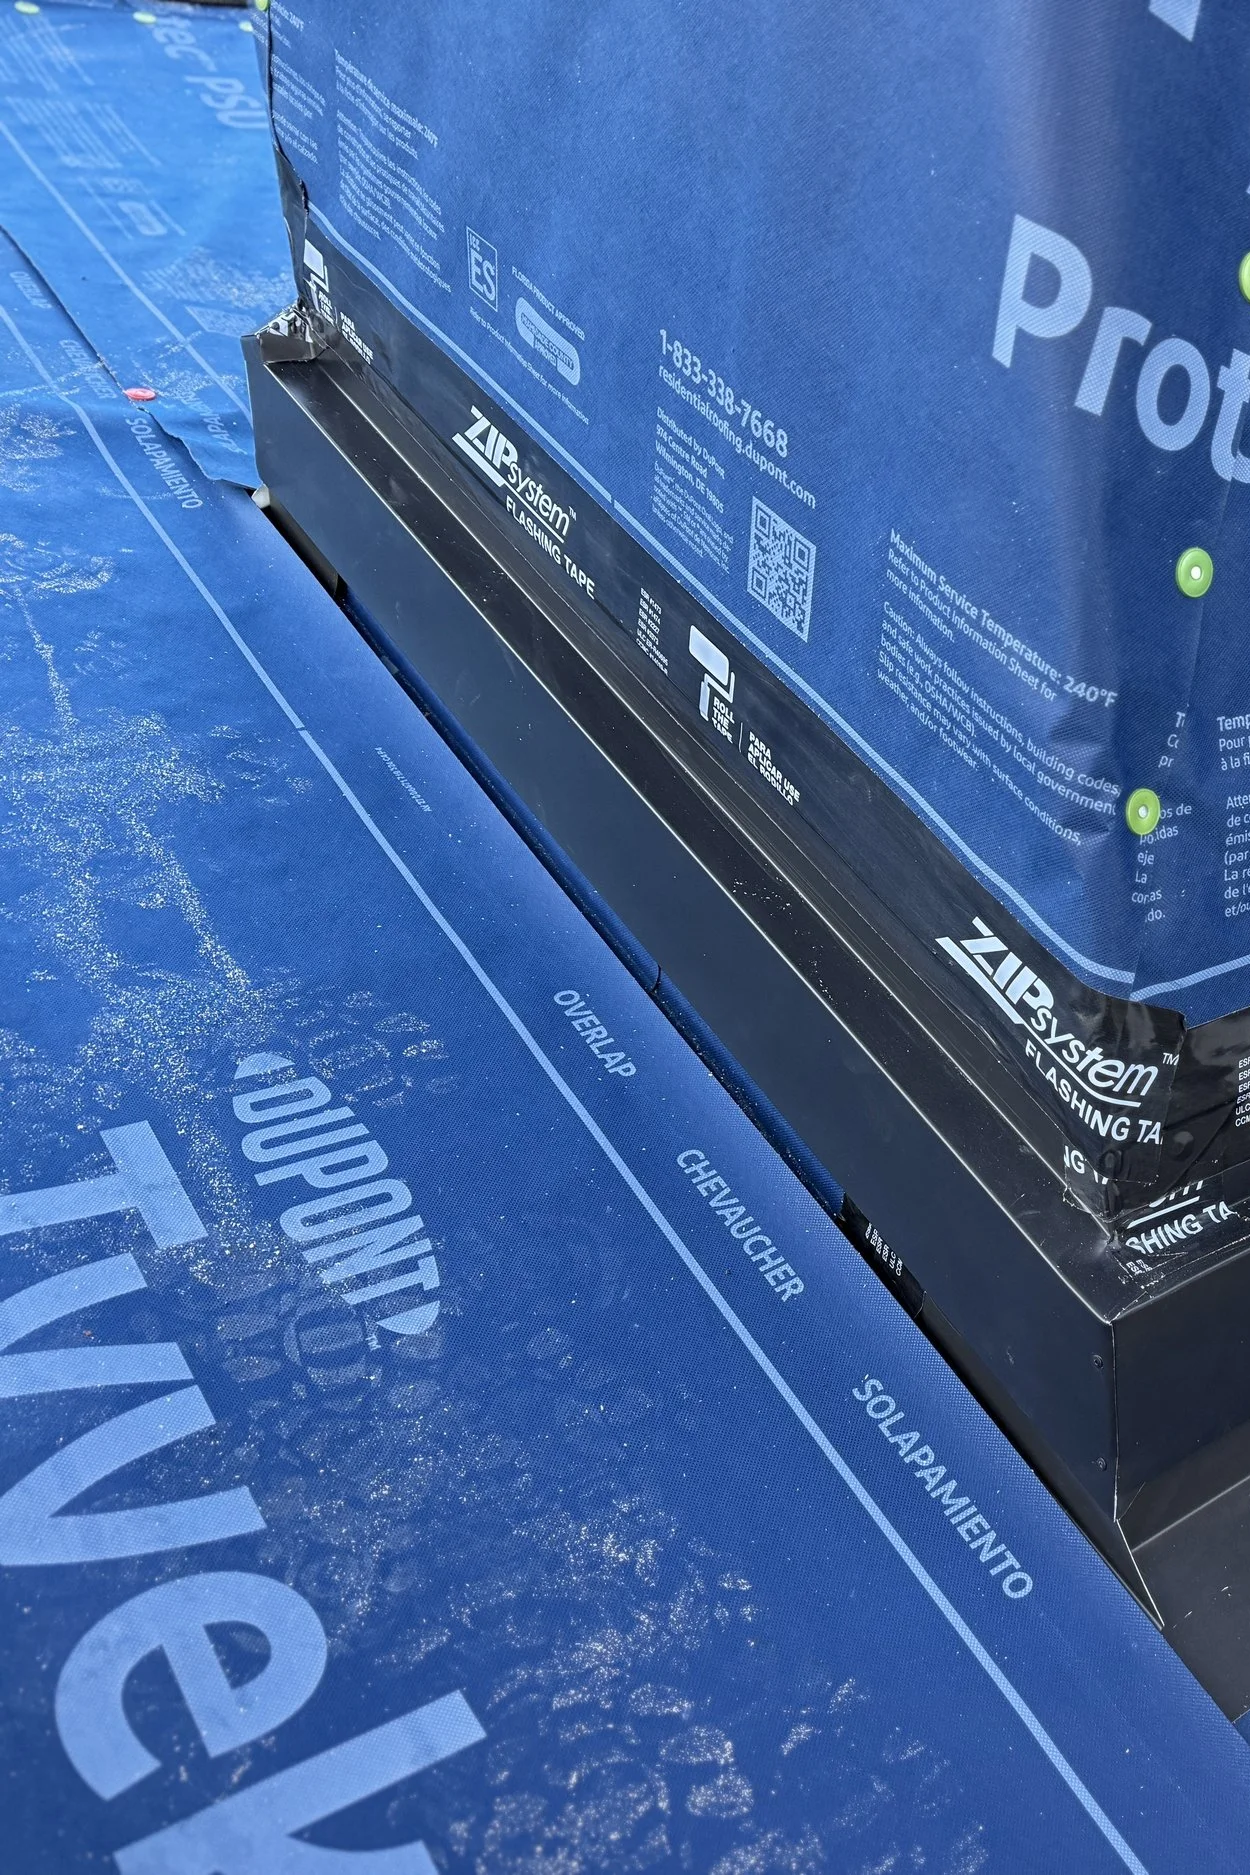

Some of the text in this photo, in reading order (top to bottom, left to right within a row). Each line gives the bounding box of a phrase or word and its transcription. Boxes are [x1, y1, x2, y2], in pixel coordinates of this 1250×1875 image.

[659, 328, 789, 458] 1-833-338-7668
[126, 417, 202, 509] SOLAPAMIENTO
[658, 364, 816, 510] residentialroofing.dupont.com
[506, 495, 595, 600] FLASHING TAPE
[886, 568, 954, 642] more information.
[888, 548, 1056, 702] Refer to Product Information Sheet for
[890, 528, 1119, 708] Maximum Service Temperature: 240°F
[711, 717, 733, 744] TAPE
[712, 707, 729, 729] THE
[713, 696, 735, 724] ROLL
[749, 731, 771, 759] PARA
[1218, 736, 1246, 752] Pour
[748, 742, 800, 802] APLICAR USE
[748, 752, 793, 806] EL RODILLO
[1220, 758, 1228, 770] à
[1230, 756, 1240, 768] la
[1175, 804, 1192, 817] de
[1135, 871, 1148, 883] La
[554, 987, 638, 1080] OVERLAP
[1025, 1039, 1163, 1145] FLASHING TA
[1236, 1102, 1250, 1114] ULC
[233, 1078, 440, 1304] DUPONT
[676, 1147, 806, 1304] CHEVAUCHER
[850, 1377, 1034, 1600] SOLAPAMIENTO
